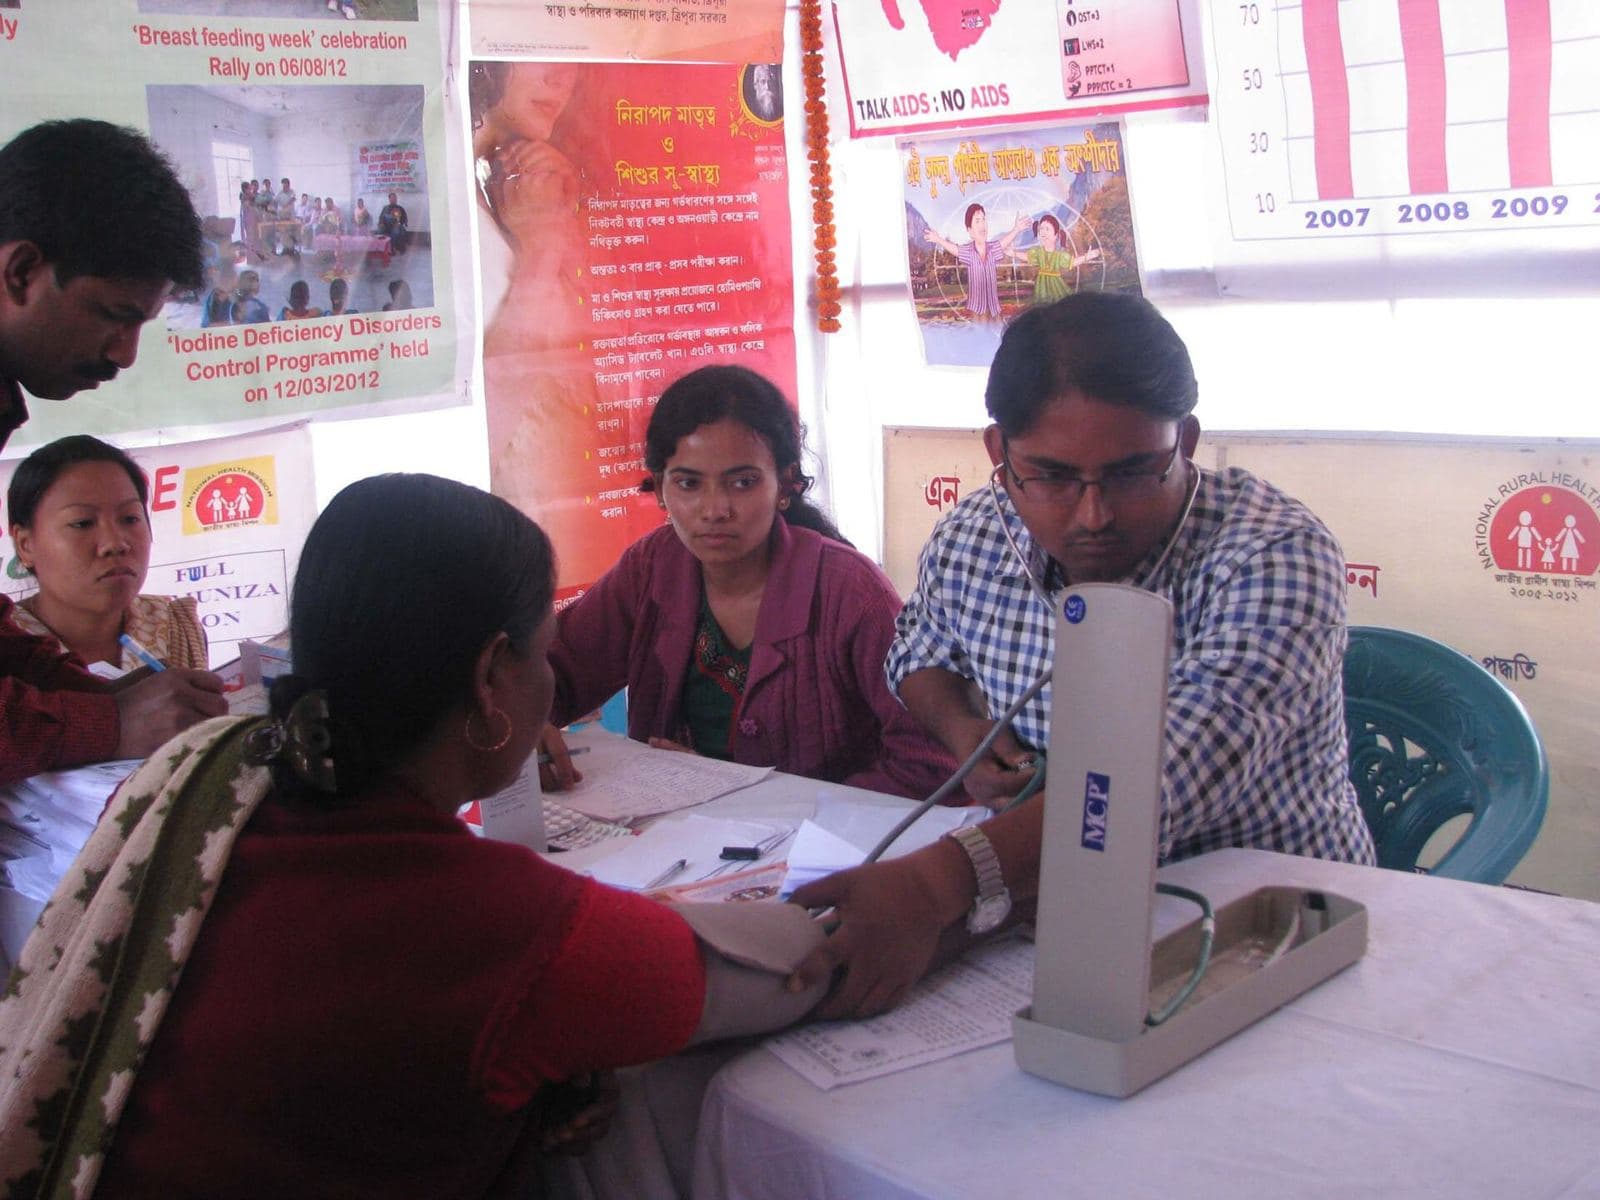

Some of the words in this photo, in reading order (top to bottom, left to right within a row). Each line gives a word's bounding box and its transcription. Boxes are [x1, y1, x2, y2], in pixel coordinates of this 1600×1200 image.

[0, 13, 18, 40] ly
[1240, 4, 1259, 26] 70
[202, 27, 265, 52] feeding
[321, 31, 407, 49] celebration
[209, 57, 250, 81] Rally
[255, 62, 275, 76] on
[279, 58, 346, 77] 06/08/12
[1243, 68, 1262, 91] 50
[616, 99, 672, 126] নিরাপদ
[676, 106, 716, 129] মাতৃত্ব
[857, 98, 891, 121] TALK
[893, 92, 931, 117] AIDS
[940, 88, 966, 112] NO
[970, 83, 1010, 109] AIDS
[661, 137, 674, 153] ও
[1250, 132, 1269, 153] 30
[615, 160, 659, 186] শিশুর
[1041, 145, 1060, 176] এক
[1256, 193, 1275, 213] 10
[1304, 208, 1371, 229] 2007
[1398, 201, 1470, 224] 2008
[1491, 195, 1568, 219] 2009
[244, 323, 343, 347] Deficiency
[350, 314, 441, 336] Disorders
[187, 356, 260, 381] Control
[391, 339, 429, 359] held
[245, 387, 268, 402] on
[274, 370, 380, 399] 12/03/2012
[1475, 498, 1501, 569] NATIONAL
[1498, 472, 1548, 497] RURAL
[176, 562, 235, 582] FULL
[1482, 653, 1538, 681] পদ্ধতি
[1085, 783, 1107, 844] MCP
